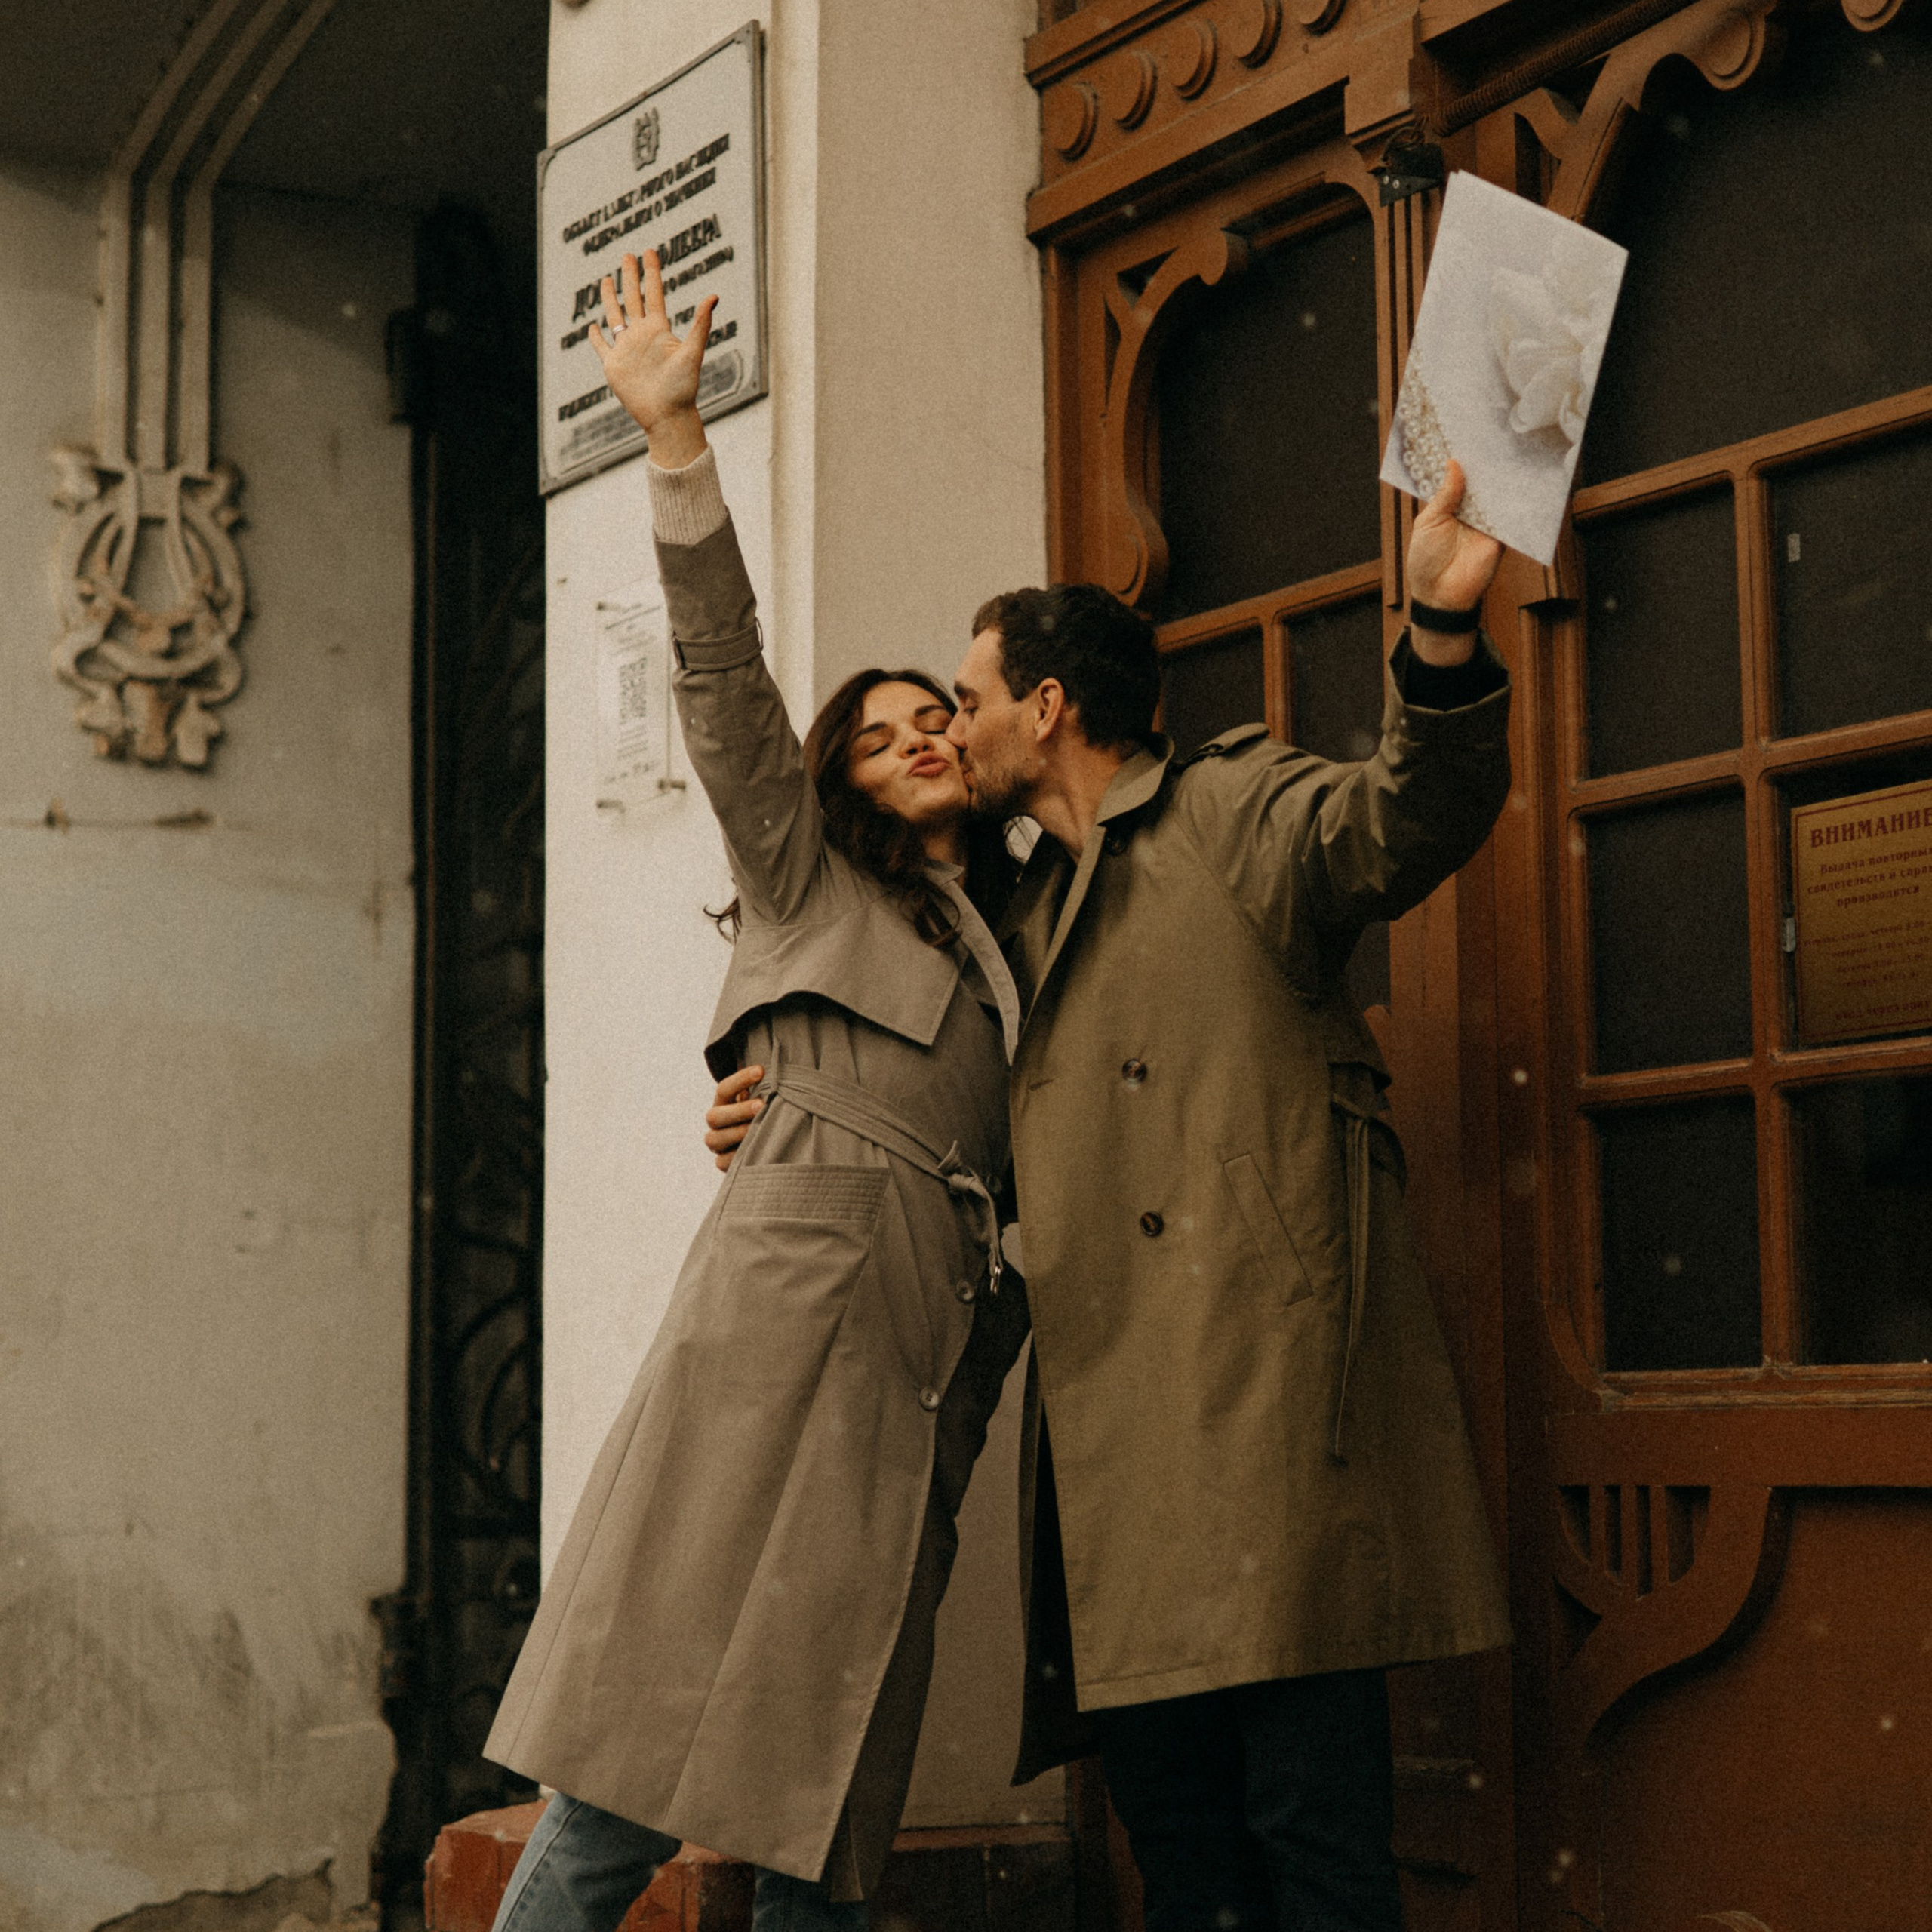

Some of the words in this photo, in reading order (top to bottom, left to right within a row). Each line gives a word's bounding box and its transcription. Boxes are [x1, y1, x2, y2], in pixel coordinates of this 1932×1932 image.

[1811, 808, 1932, 848] ВНИМАНИЕ
[1820, 859, 1865, 875] Выдача
[1807, 873, 1885, 894] свидетельств
[1889, 871, 1896, 880] и
